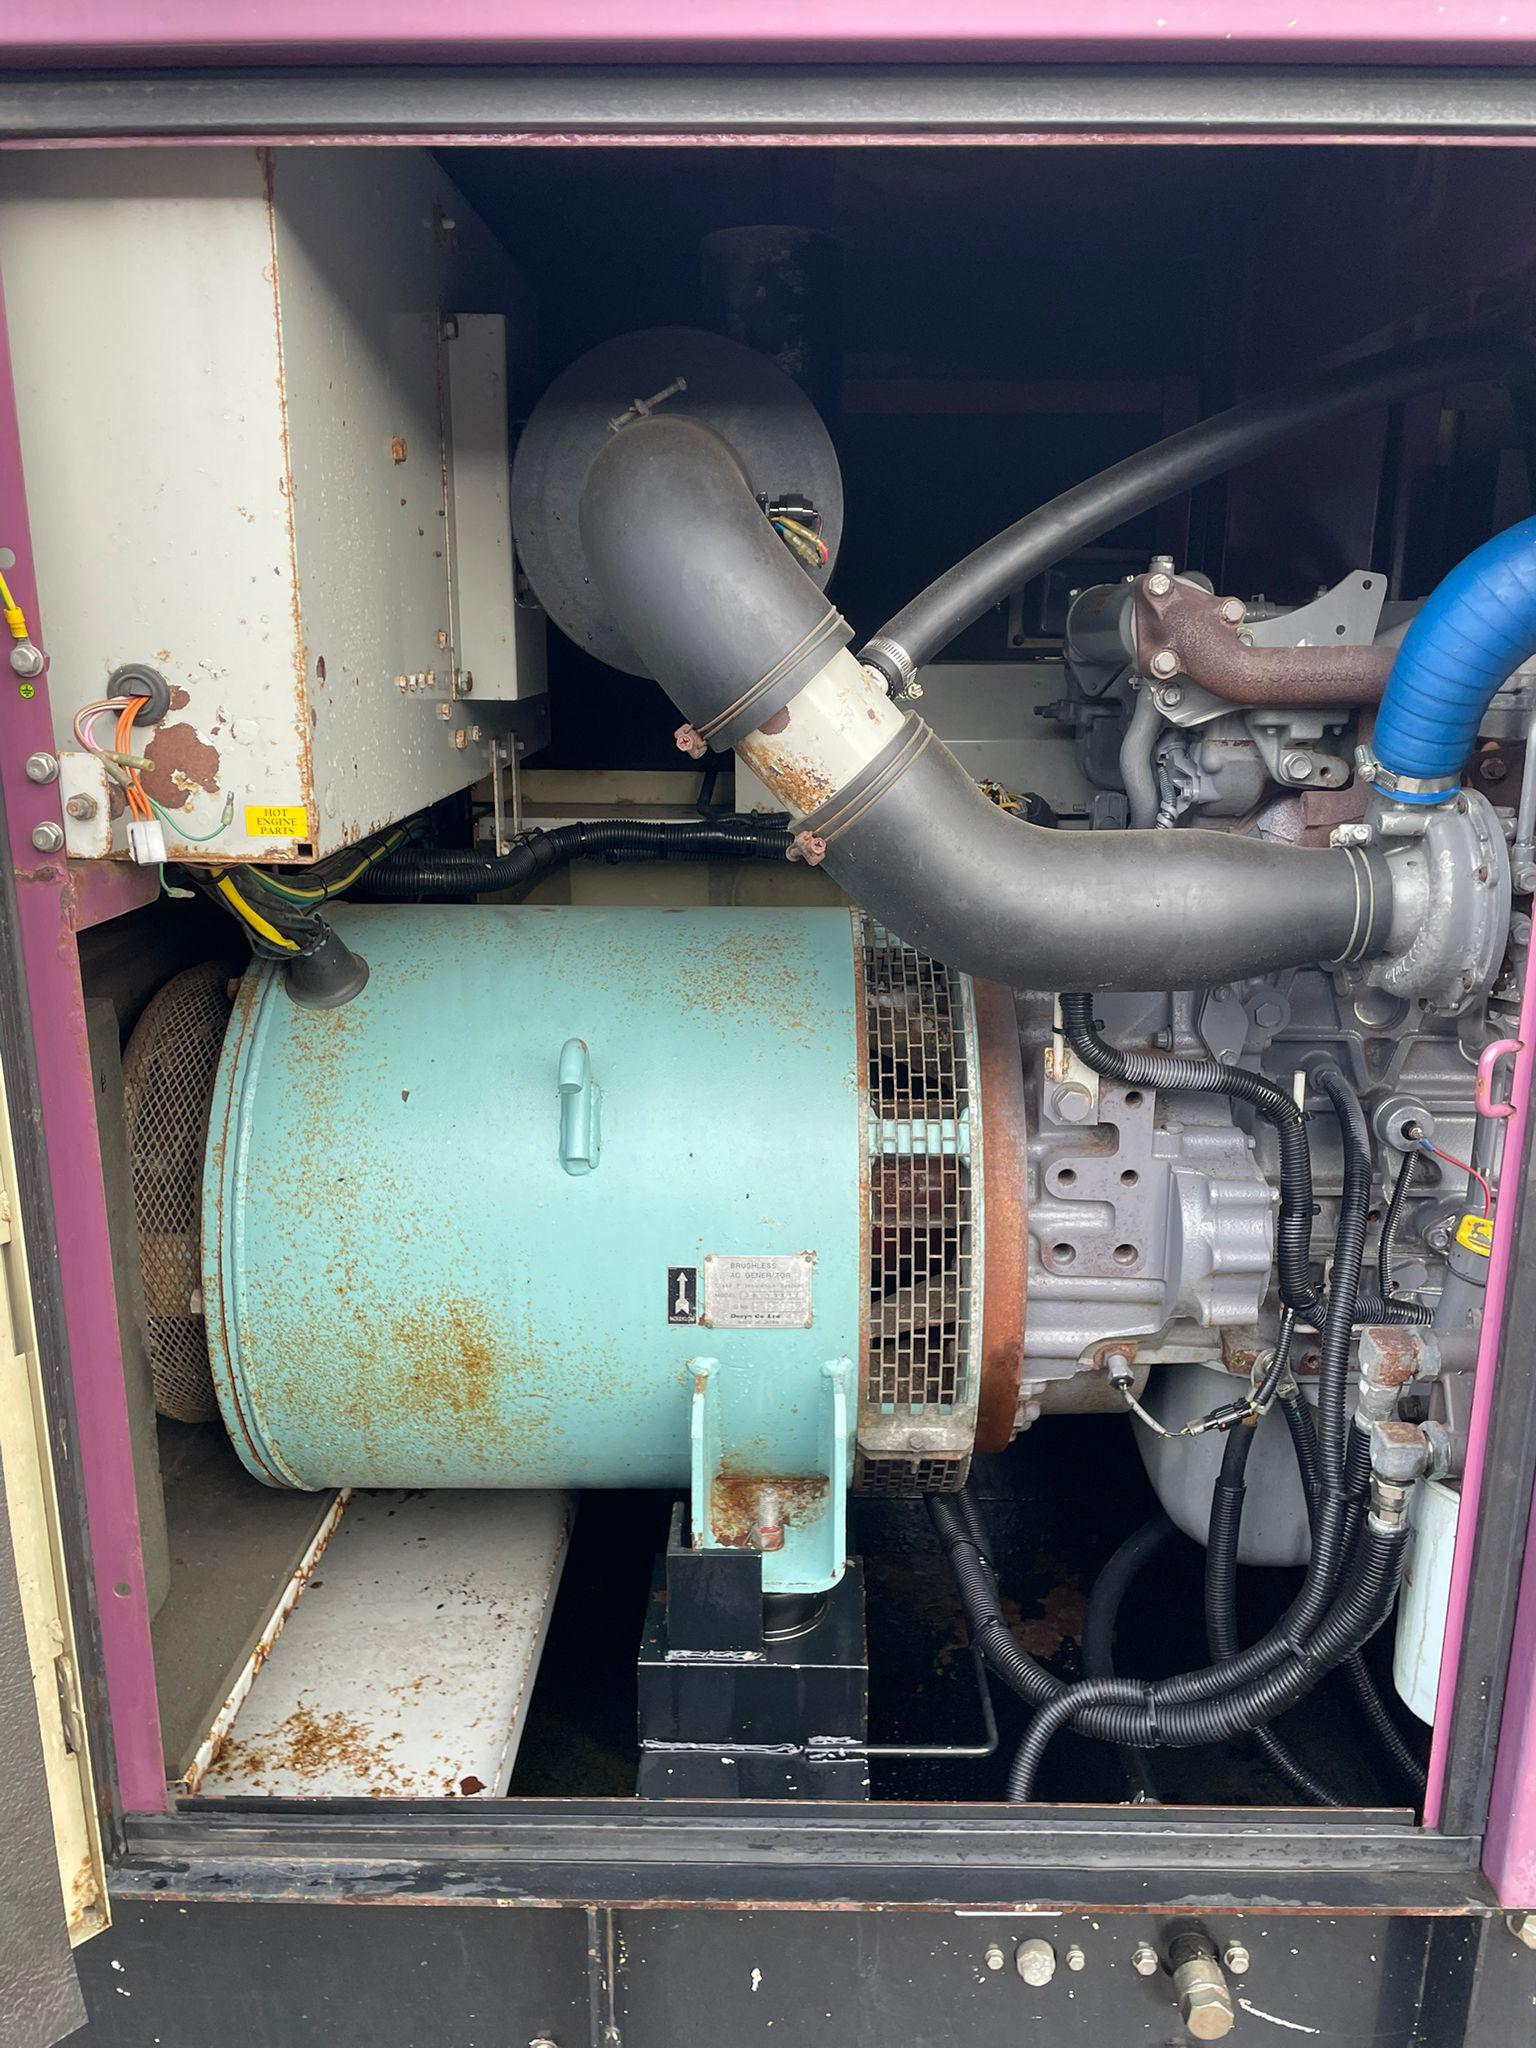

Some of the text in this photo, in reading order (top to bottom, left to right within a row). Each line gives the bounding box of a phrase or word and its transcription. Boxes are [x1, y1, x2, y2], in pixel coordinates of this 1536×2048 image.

[264, 808, 288, 817] HOT
[256, 817, 297, 826] ENGINE
[260, 826, 295, 835] PARTS
